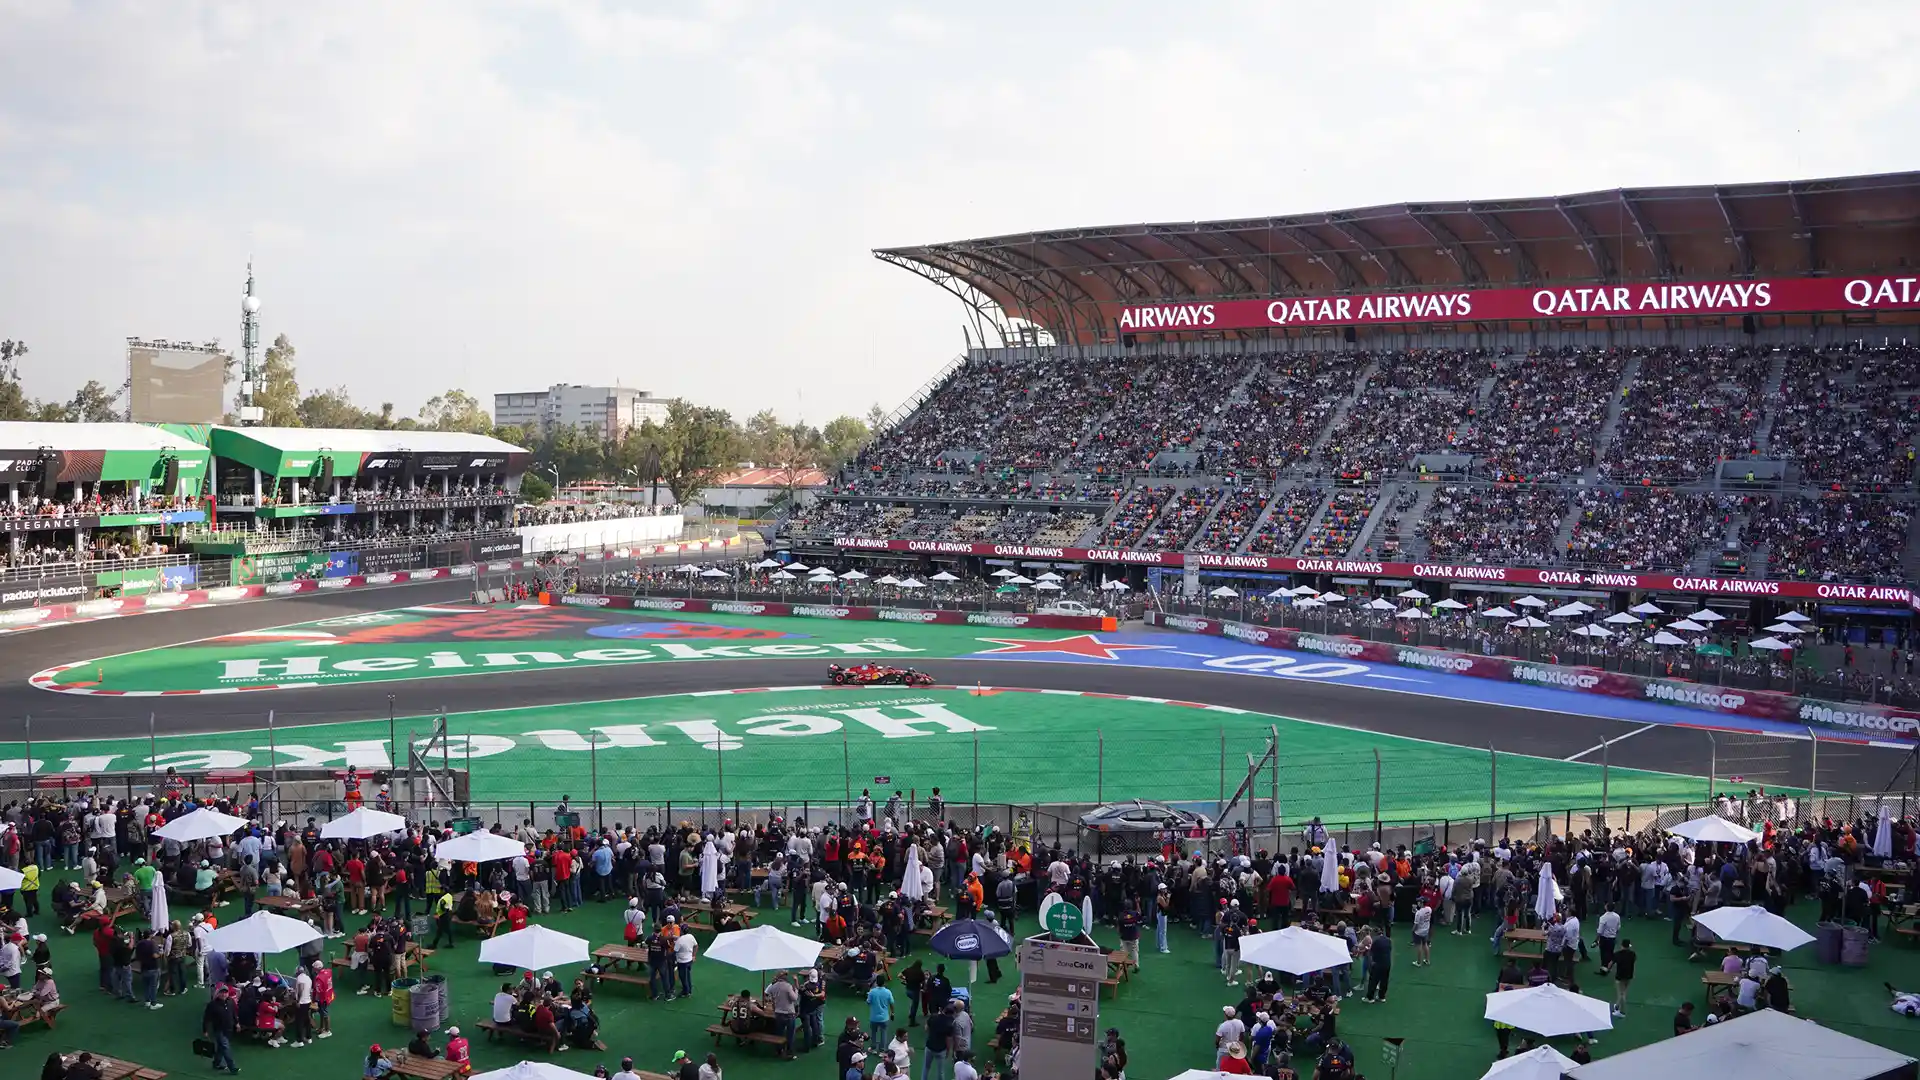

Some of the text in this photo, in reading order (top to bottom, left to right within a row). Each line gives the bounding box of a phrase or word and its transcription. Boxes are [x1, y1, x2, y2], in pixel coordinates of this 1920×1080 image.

[1533, 282, 1771, 316] QATAR AIRWAYS
[1267, 293, 1471, 325] QATAR AIRWAYS
[1120, 304, 1215, 328] AIRWAYS
[399, 502, 449, 510] ADRENALINE
[453, 500, 477, 508] MEETS
[5, 519, 80, 531] ELEGANCE
[856, 538, 889, 548] AIRWAYS
[909, 540, 972, 553] QATAR AIRWAYS
[994, 545, 1063, 557] QATAR AIRWAYS
[1087, 549, 1161, 562] QATAR AIRWAYS
[1199, 555, 1268, 568] ATAR AIRWAYS
[1296, 560, 1382, 573] QATAR AIRWAYS
[1413, 565, 1505, 579] QATAR AIRWAYS
[1538, 571, 1580, 584] QATAR
[1673, 577, 1779, 594] QATAR AIRWAYS
[1817, 585, 1866, 598] QATAR
[561, 596, 610, 606] #MexicoGP
[634, 599, 685, 610] #MexicoGP
[711, 602, 765, 614] #MexicoGP
[793, 605, 849, 618] #MexicoGP
[878, 610, 937, 622] #MexicoGP
[967, 613, 1029, 626] #MexicoGP
[1165, 616, 1208, 631] #MexicoGP
[1223, 623, 1269, 642] #MexicoGP
[1297, 634, 1363, 656] #MexicoGP
[1398, 650, 1473, 671] #MexicoGP
[1513, 665, 1599, 689] #MexicoGP
[1645, 683, 1745, 710] #MexicoGP
[1800, 704, 1920, 733] #MexicoGP
